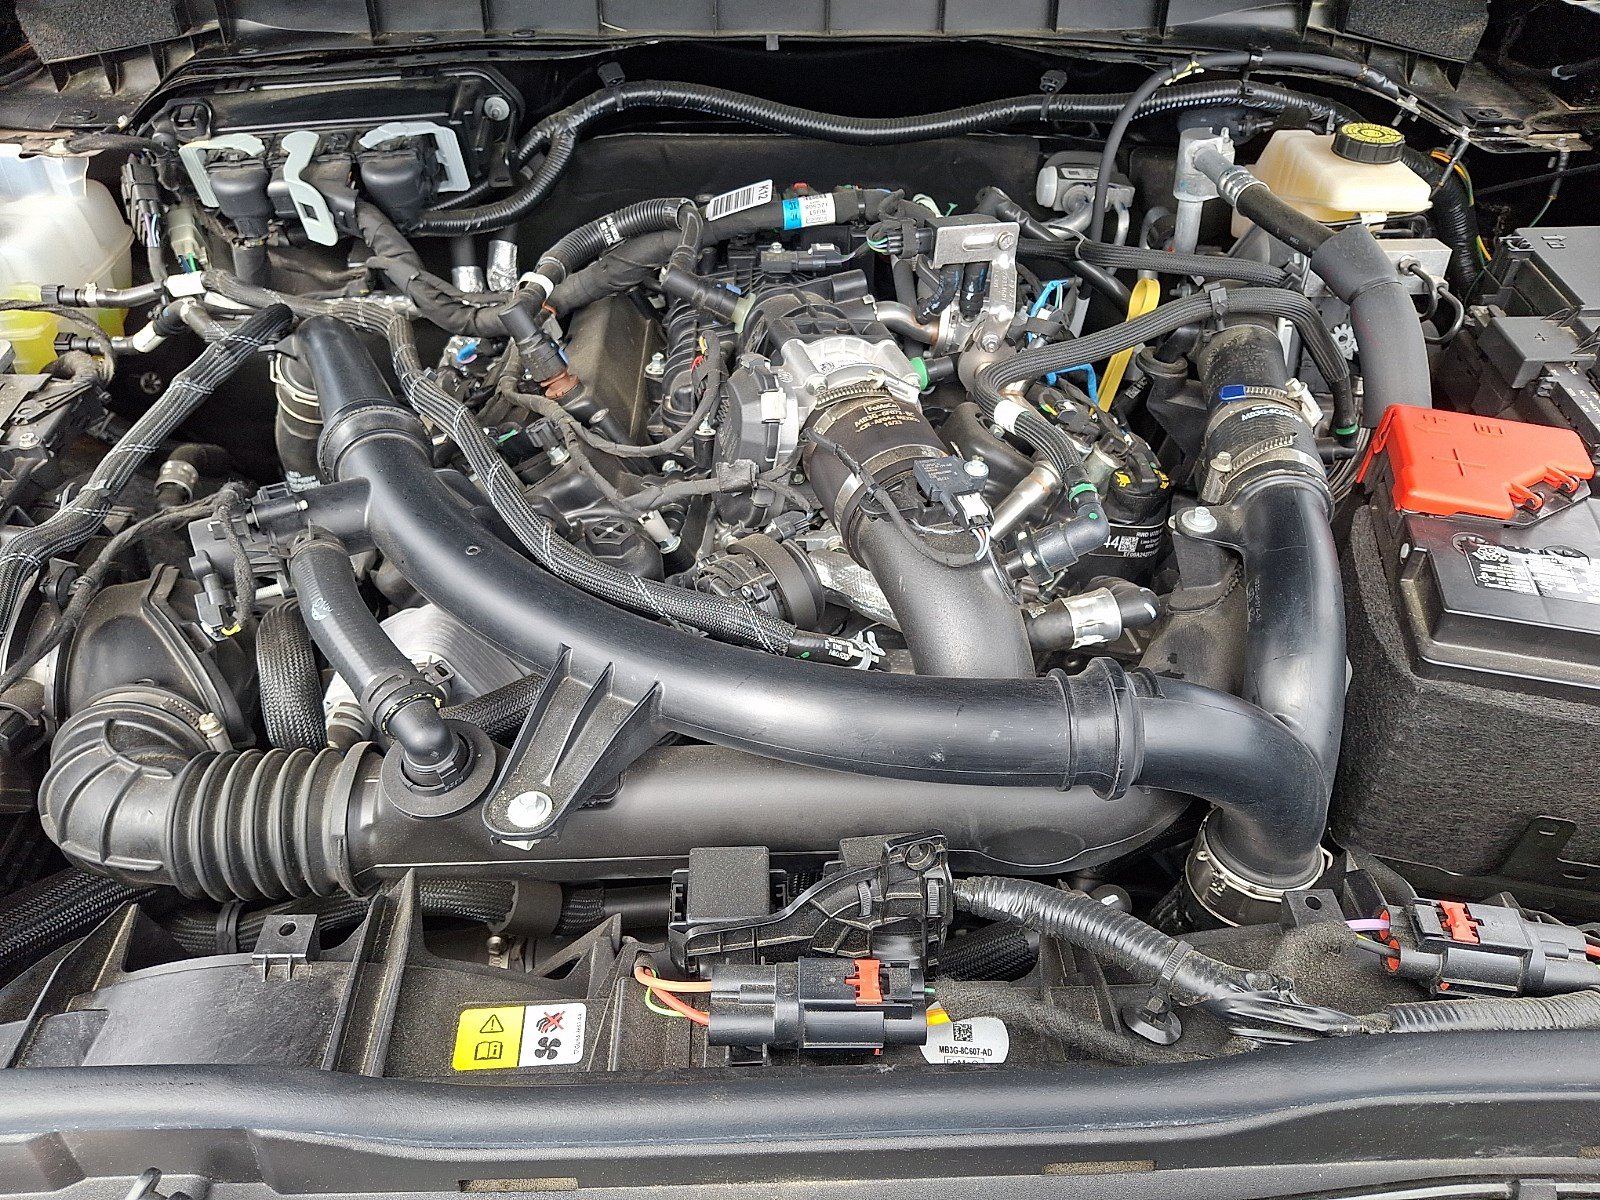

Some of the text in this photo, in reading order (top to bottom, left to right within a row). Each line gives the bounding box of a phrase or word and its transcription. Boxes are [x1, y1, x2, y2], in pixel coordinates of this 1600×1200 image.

[758, 184, 769, 201] K12
[867, 402, 897, 411] FoMoCo
[938, 1045, 993, 1056] MB3G-8C607-AD
